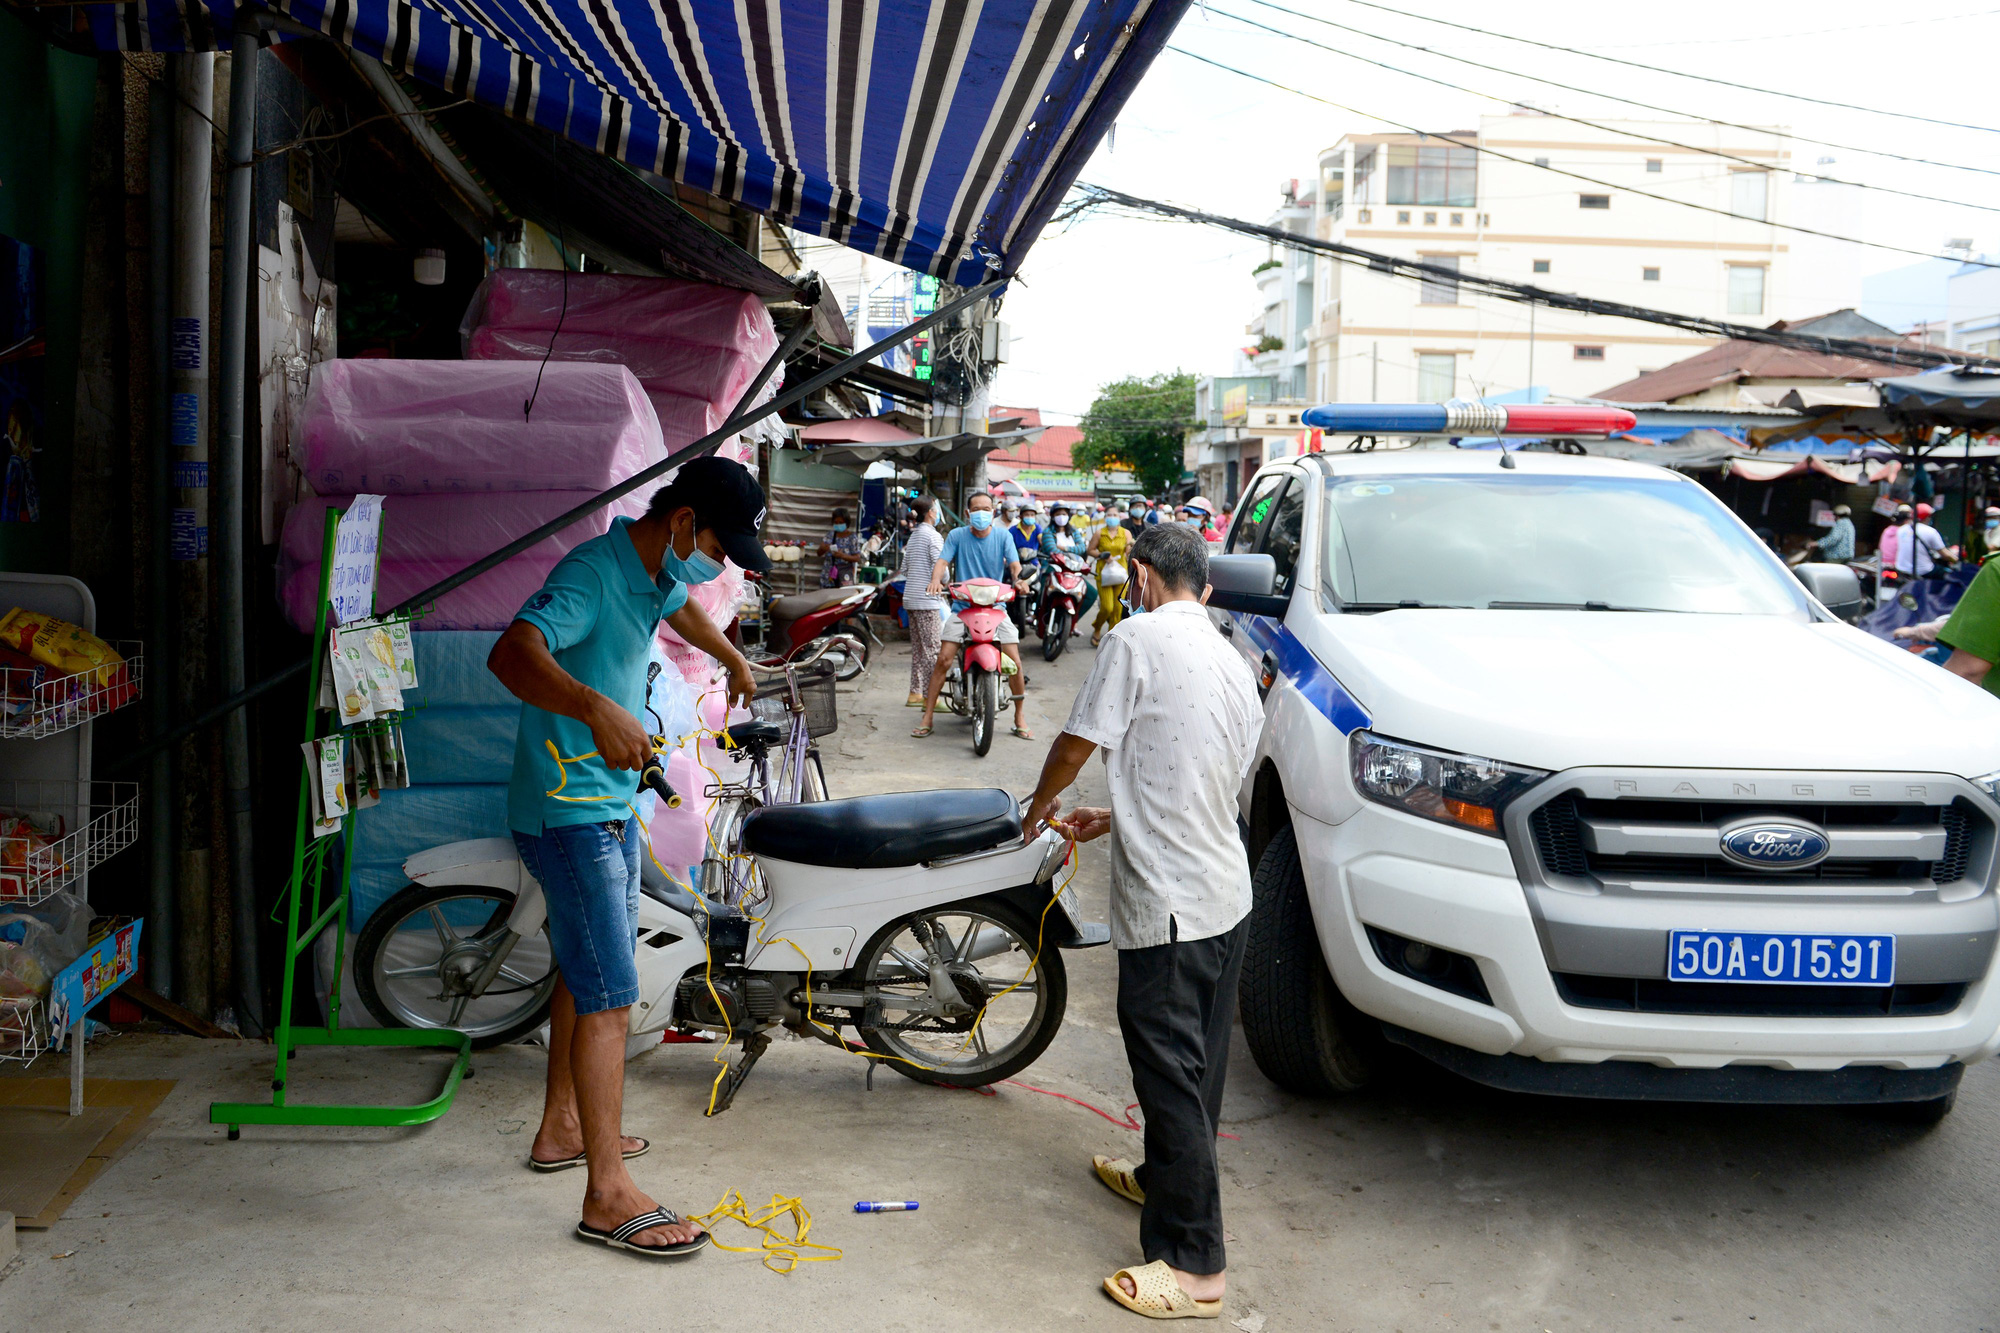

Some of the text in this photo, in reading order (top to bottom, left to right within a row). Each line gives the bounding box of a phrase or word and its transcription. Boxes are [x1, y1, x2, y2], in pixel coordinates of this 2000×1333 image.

[1614, 778, 1927, 799] RANGER
[1748, 832, 1807, 857] Ford
[1676, 934, 1878, 980] 50A-015.91
